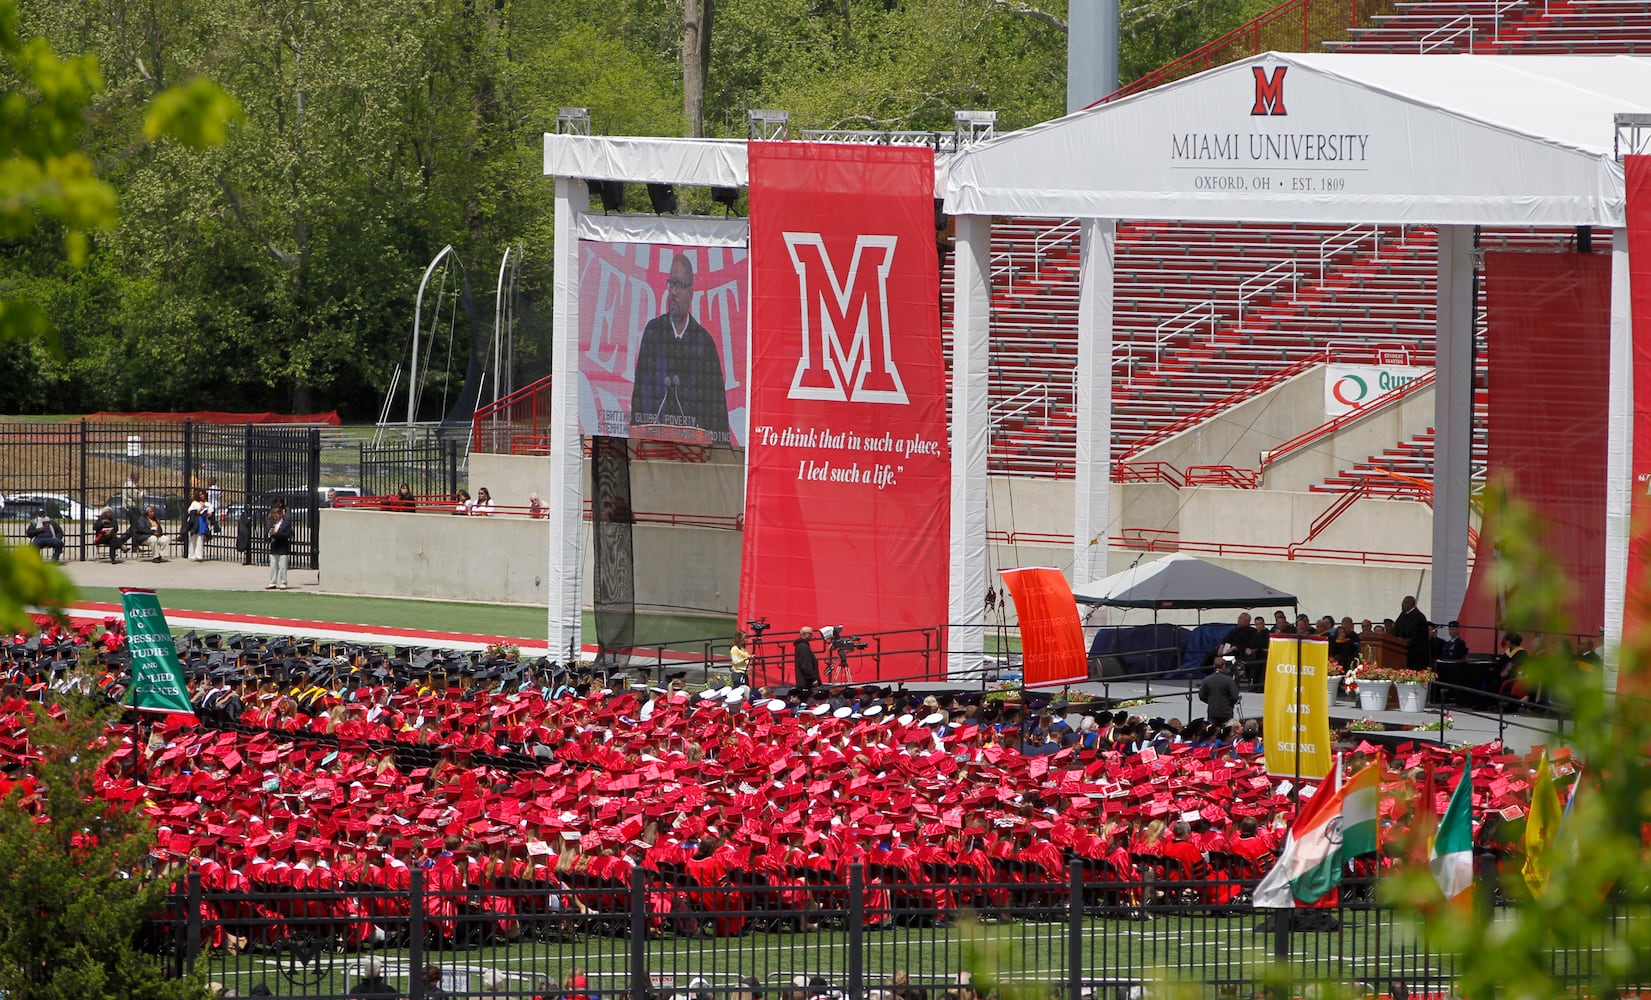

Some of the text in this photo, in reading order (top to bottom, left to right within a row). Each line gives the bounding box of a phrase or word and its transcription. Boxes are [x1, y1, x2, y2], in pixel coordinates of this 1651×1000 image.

[1250, 66, 1288, 116] M
[1171, 133, 1369, 161] MIAMI UNIVERSITY
[1194, 177, 1345, 191] OXFORD, OH EST. 1809
[782, 231, 910, 405] M
[781, 427, 817, 448] think
[819, 429, 846, 450] that
[848, 431, 861, 450] in
[864, 432, 893, 452] such
[896, 440, 904, 453] a
[905, 434, 941, 459] place,
[797, 460, 806, 480] I
[807, 461, 829, 481] led
[830, 463, 860, 484] such
[862, 471, 871, 484] a
[137, 672, 175, 683] ALIED
[1276, 664, 1316, 676] COLEGE
[1277, 742, 1316, 754] SCINCE
